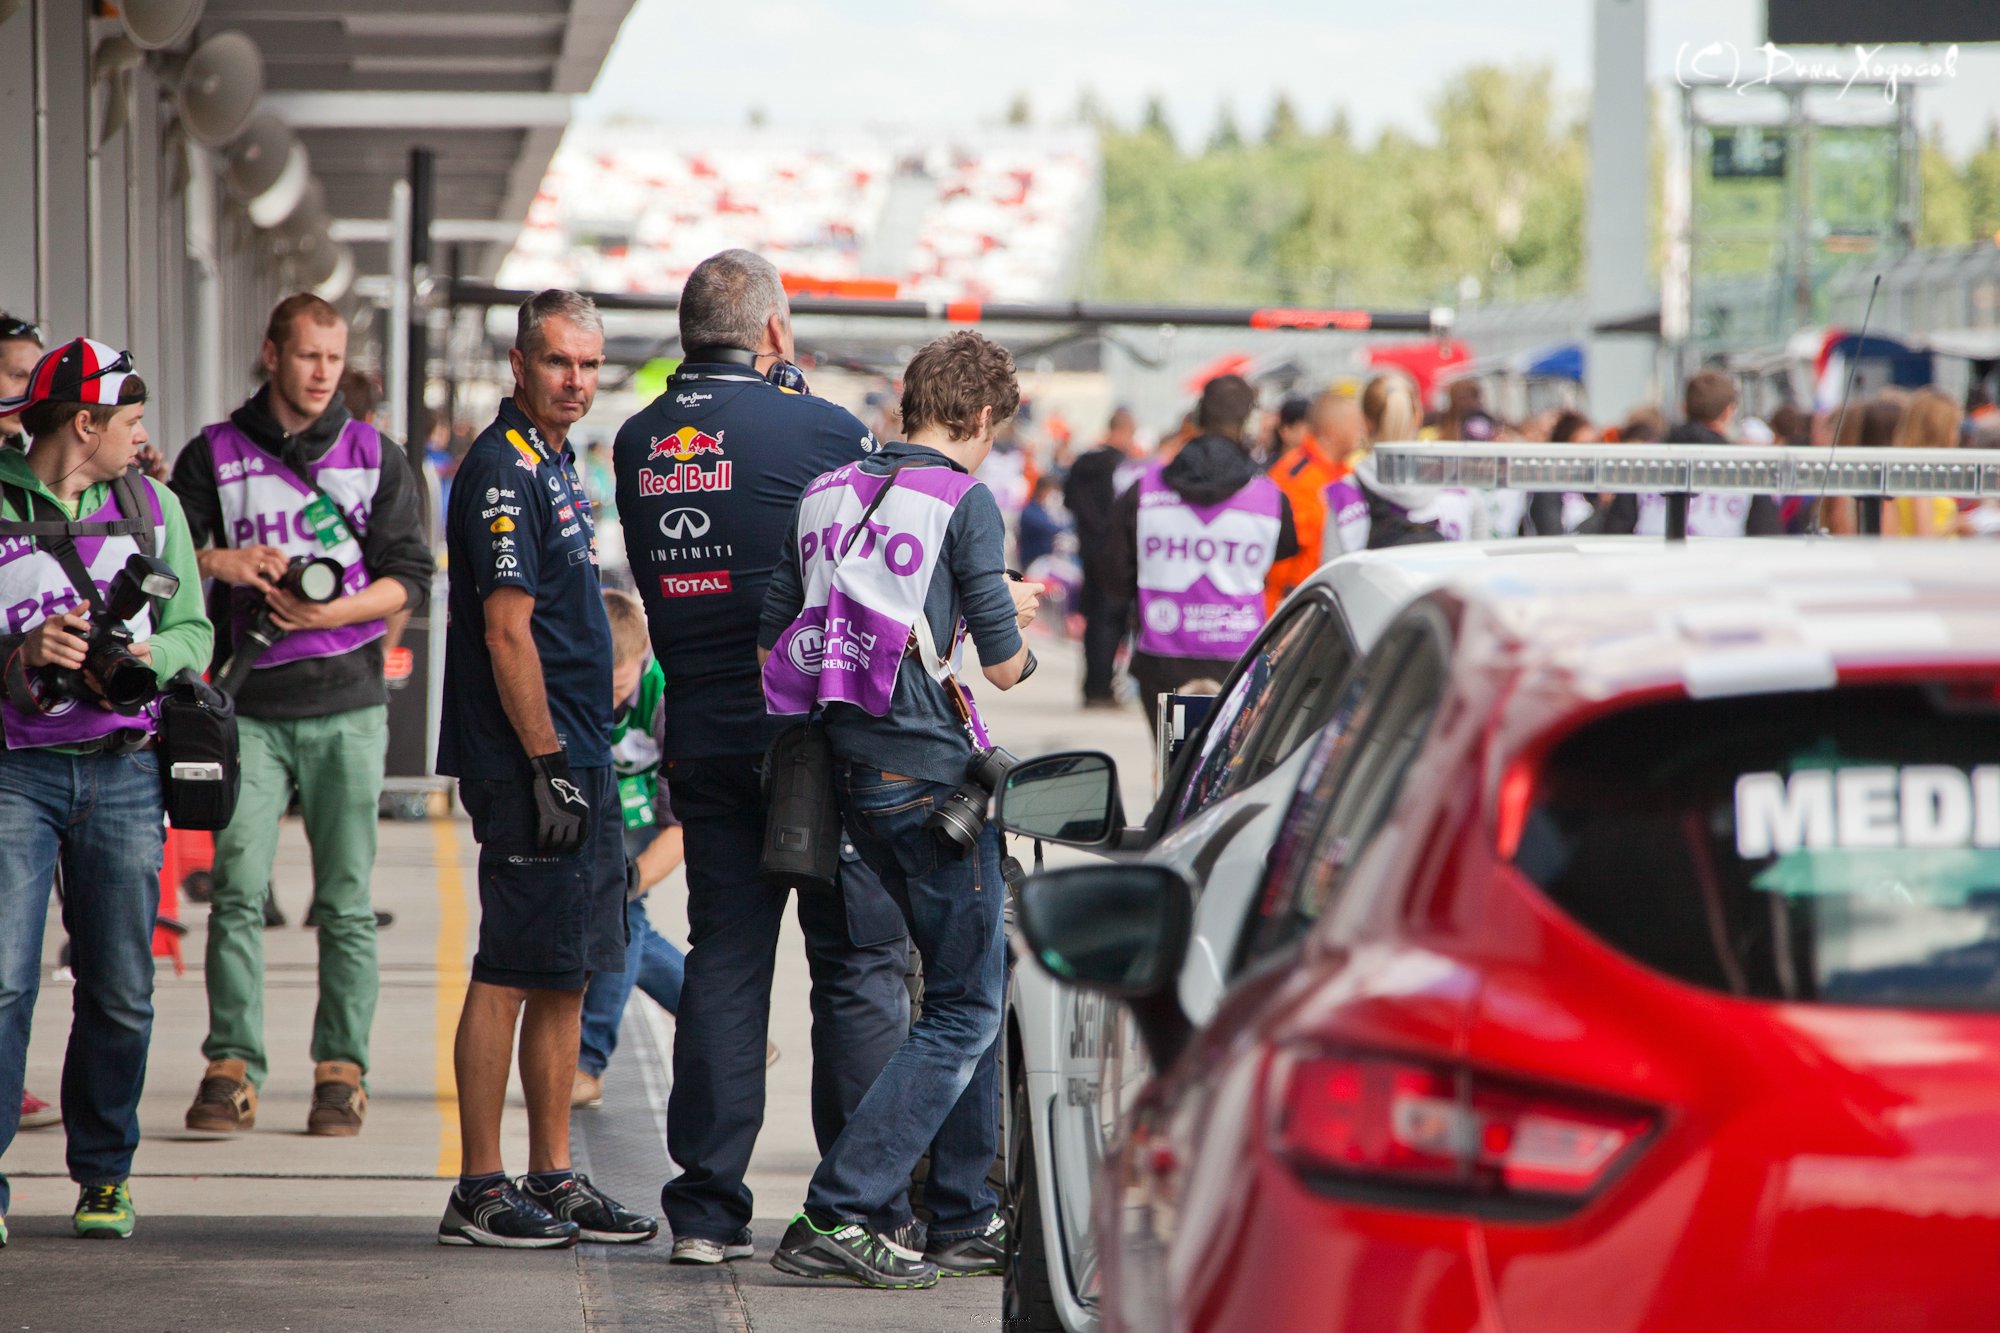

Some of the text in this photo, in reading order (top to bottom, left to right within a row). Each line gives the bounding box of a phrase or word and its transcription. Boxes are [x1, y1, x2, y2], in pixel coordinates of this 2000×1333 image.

[218, 456, 265, 480] 2014
[639, 460, 733, 497] Red Bull
[482, 504, 522, 519] RENAULT
[0, 535, 31, 559] 014
[650, 544, 733, 562] INFINITI
[1146, 536, 1264, 566] PHOTO
[663, 577, 728, 594] TOTAL
